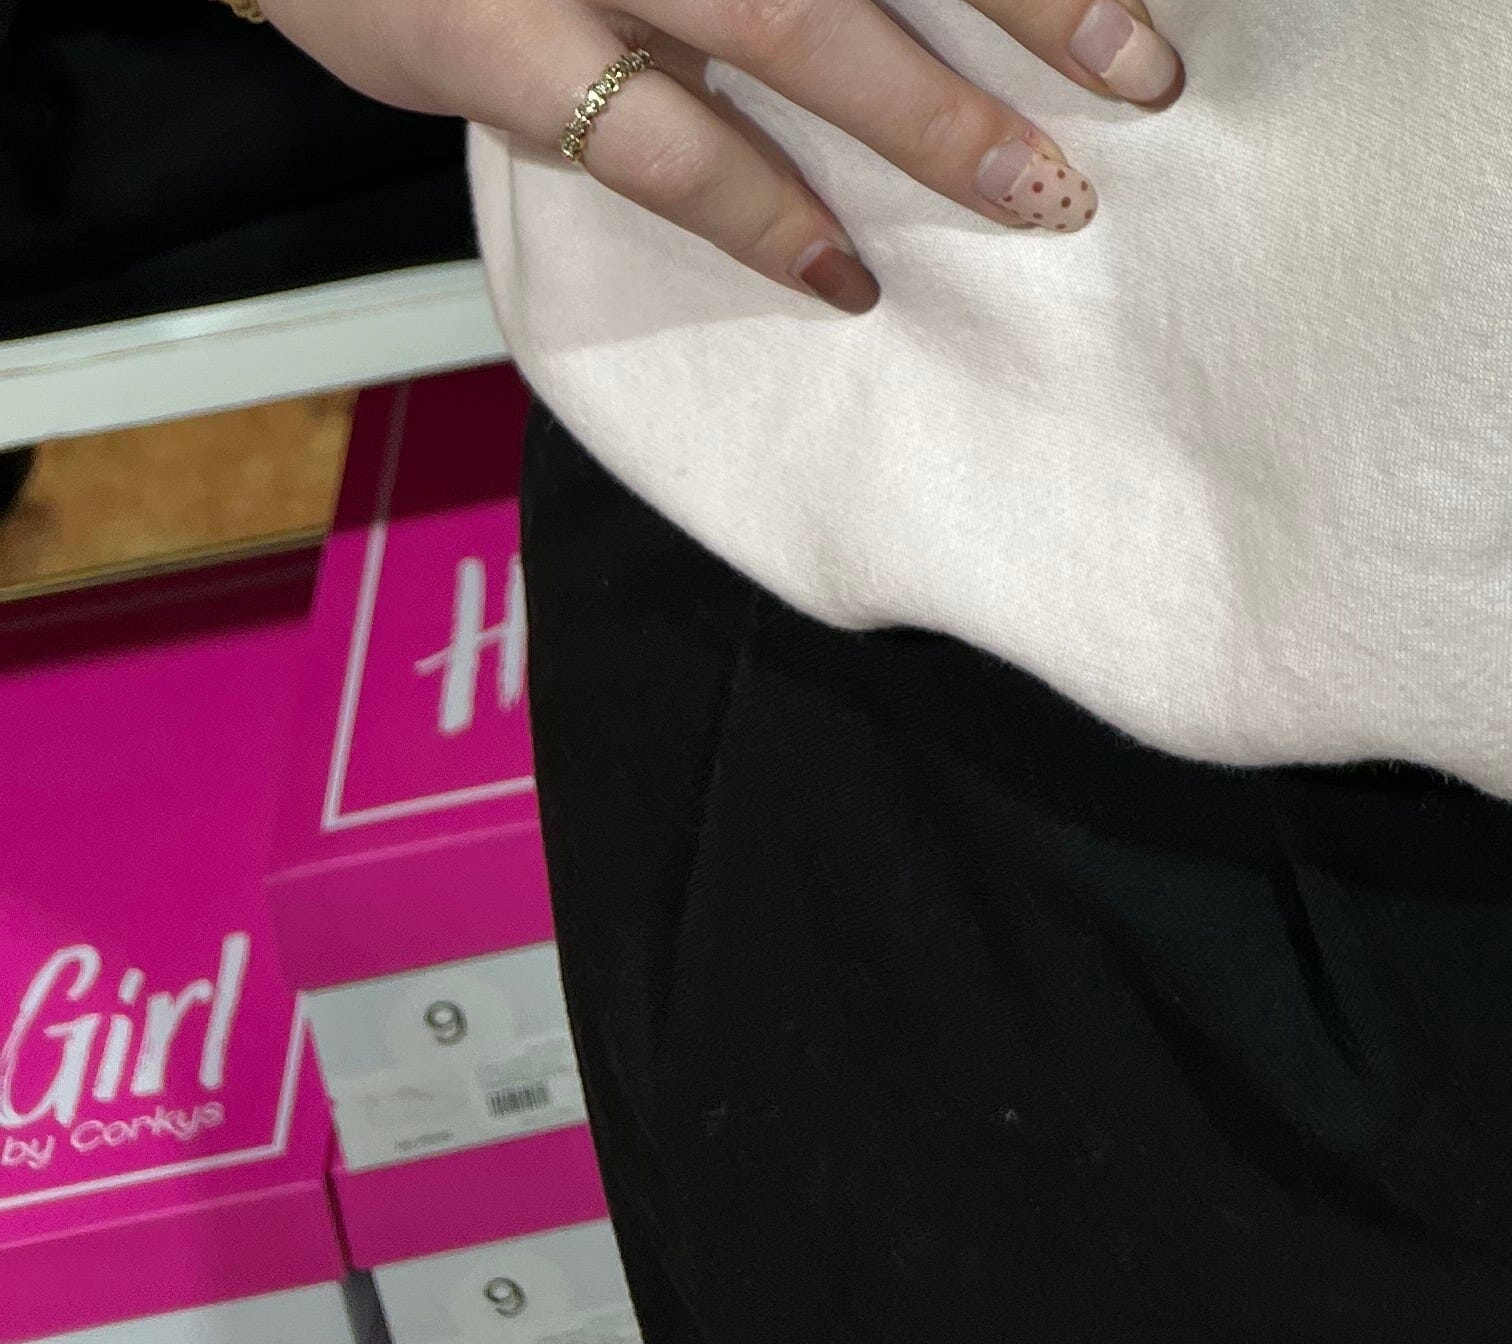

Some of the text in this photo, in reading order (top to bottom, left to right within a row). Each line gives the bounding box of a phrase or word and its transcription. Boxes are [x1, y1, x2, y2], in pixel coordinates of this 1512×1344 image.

[0, 932, 249, 1128] Girl
[423, 999, 468, 1046] 9
[1, 1134, 56, 1169] by
[483, 1275, 528, 1318] 9
